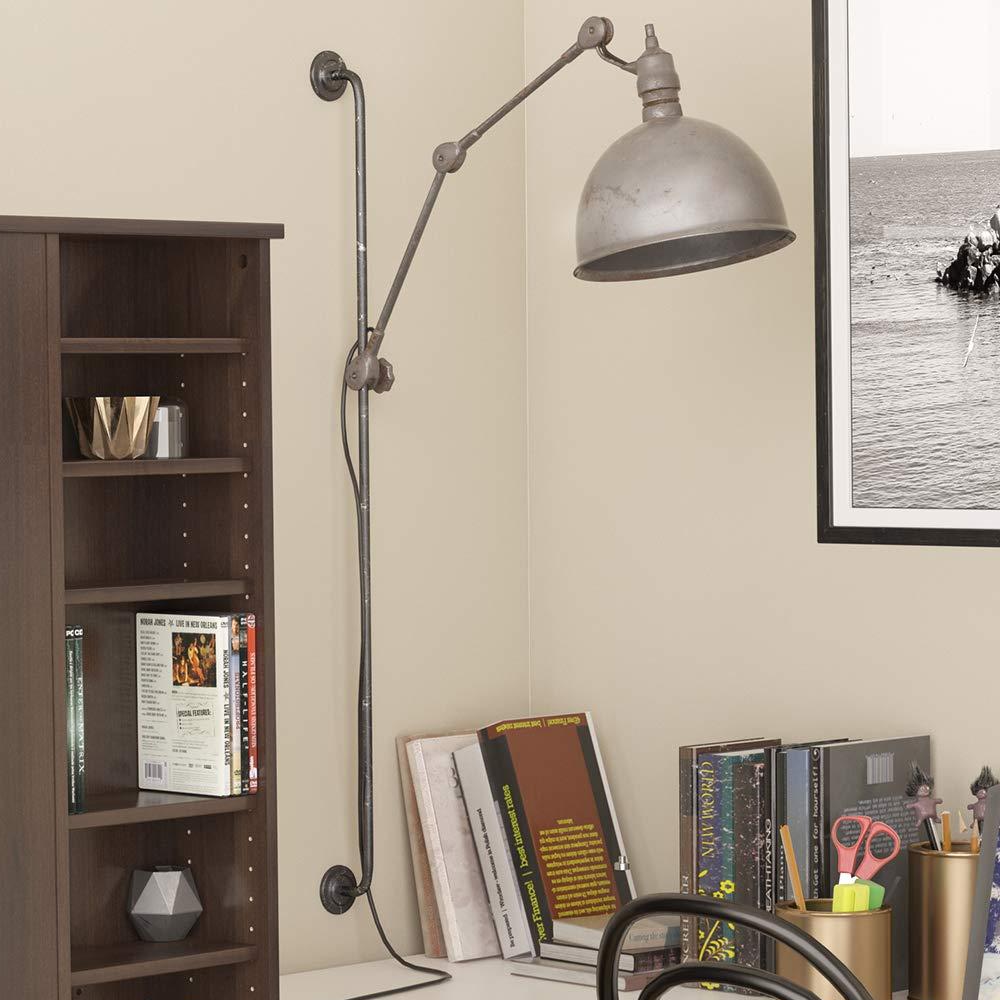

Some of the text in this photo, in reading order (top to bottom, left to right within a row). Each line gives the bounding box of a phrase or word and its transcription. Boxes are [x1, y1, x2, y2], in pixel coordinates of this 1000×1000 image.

[140, 618, 218, 630] NORAH JONES LIVE IN NEW ORLEANS
[502, 783, 529, 868] best interest rates
[699, 761, 715, 858] NEW WORLD
[524, 880, 542, 922] Finance!
